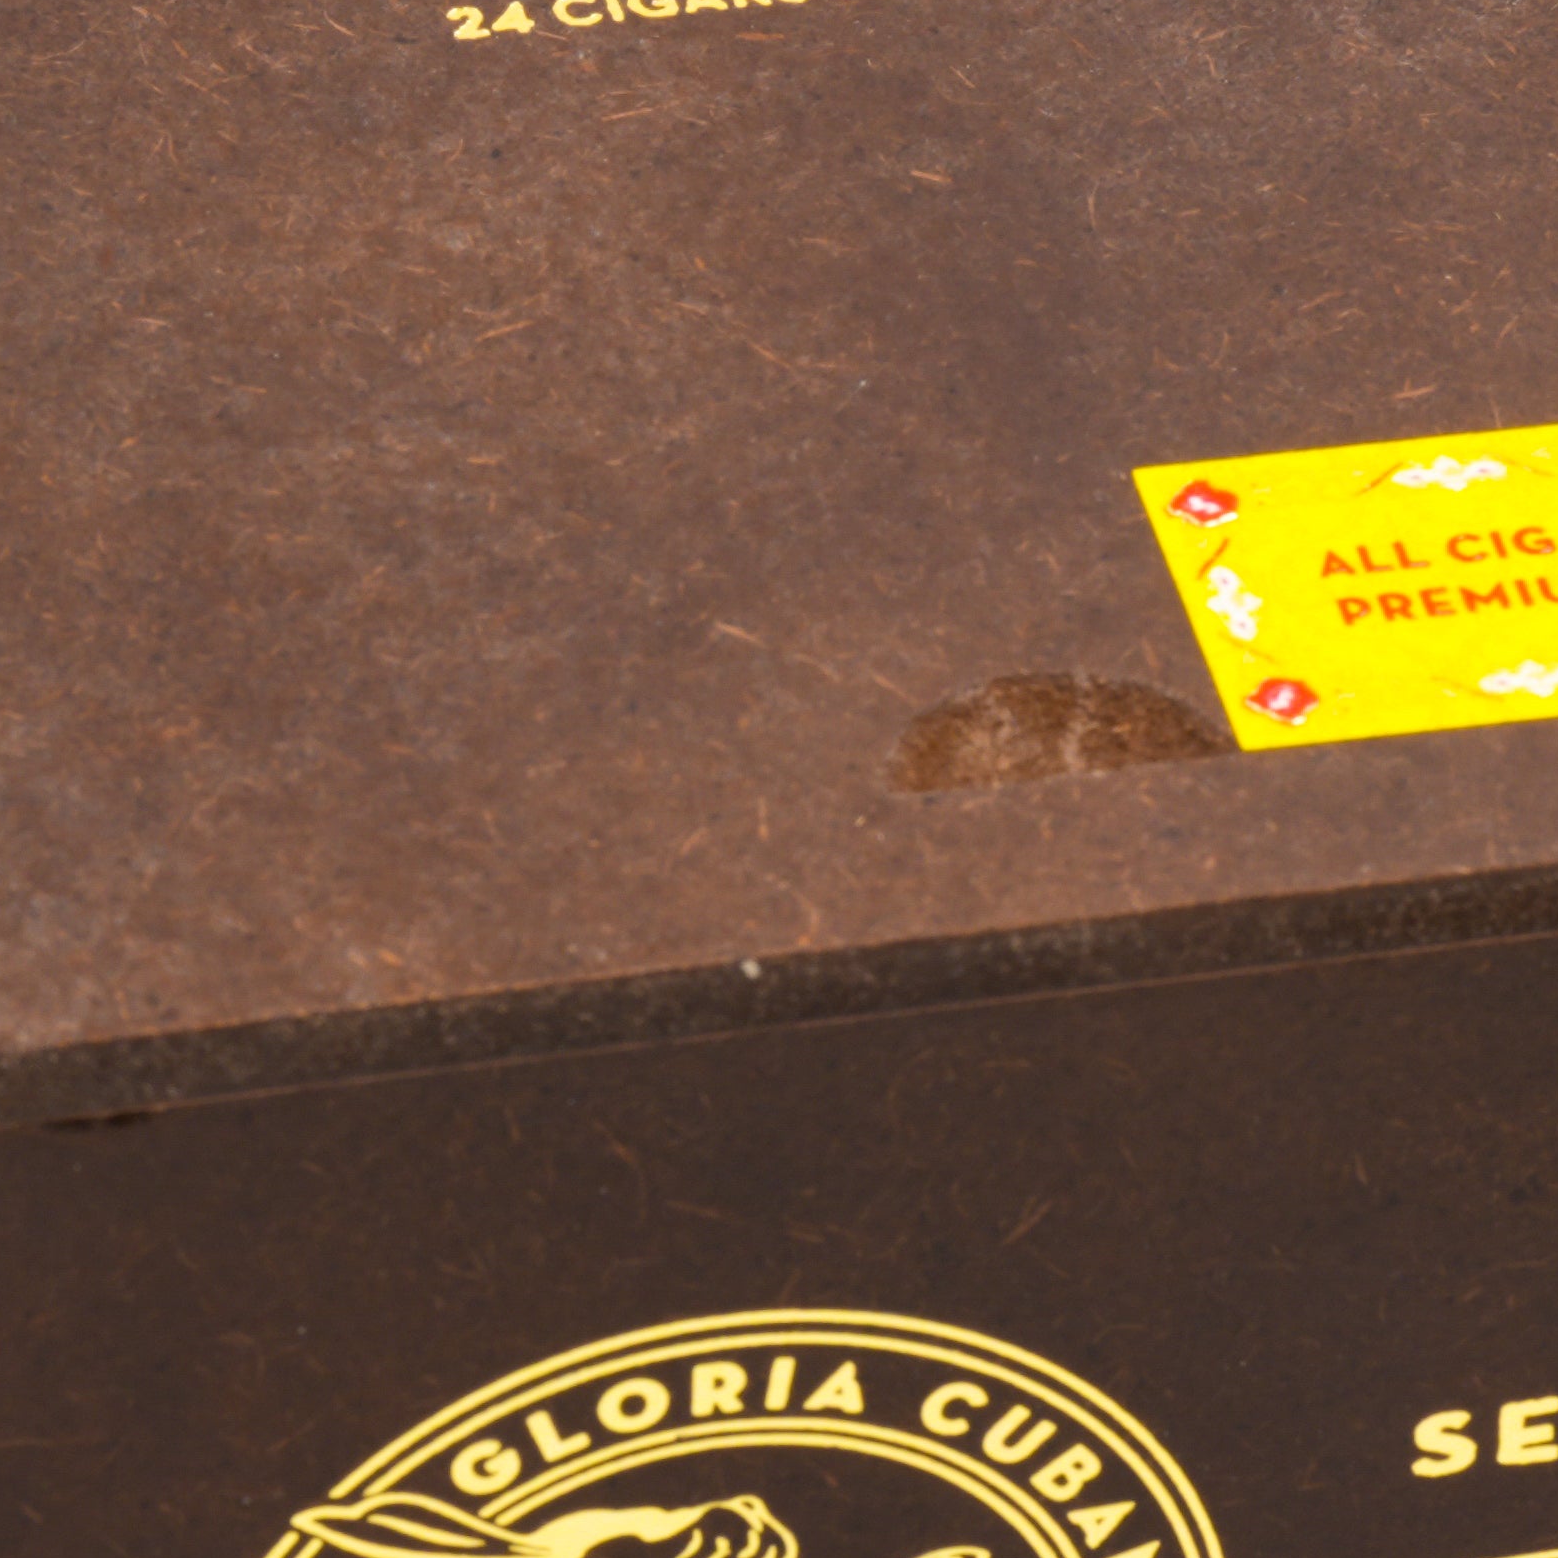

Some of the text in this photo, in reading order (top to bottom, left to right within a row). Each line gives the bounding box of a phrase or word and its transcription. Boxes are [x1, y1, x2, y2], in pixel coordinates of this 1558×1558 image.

[446, 1, 536, 40] 24
[1321, 540, 1431, 578] ALL
[449, 1355, 865, 1496] GLORIA
